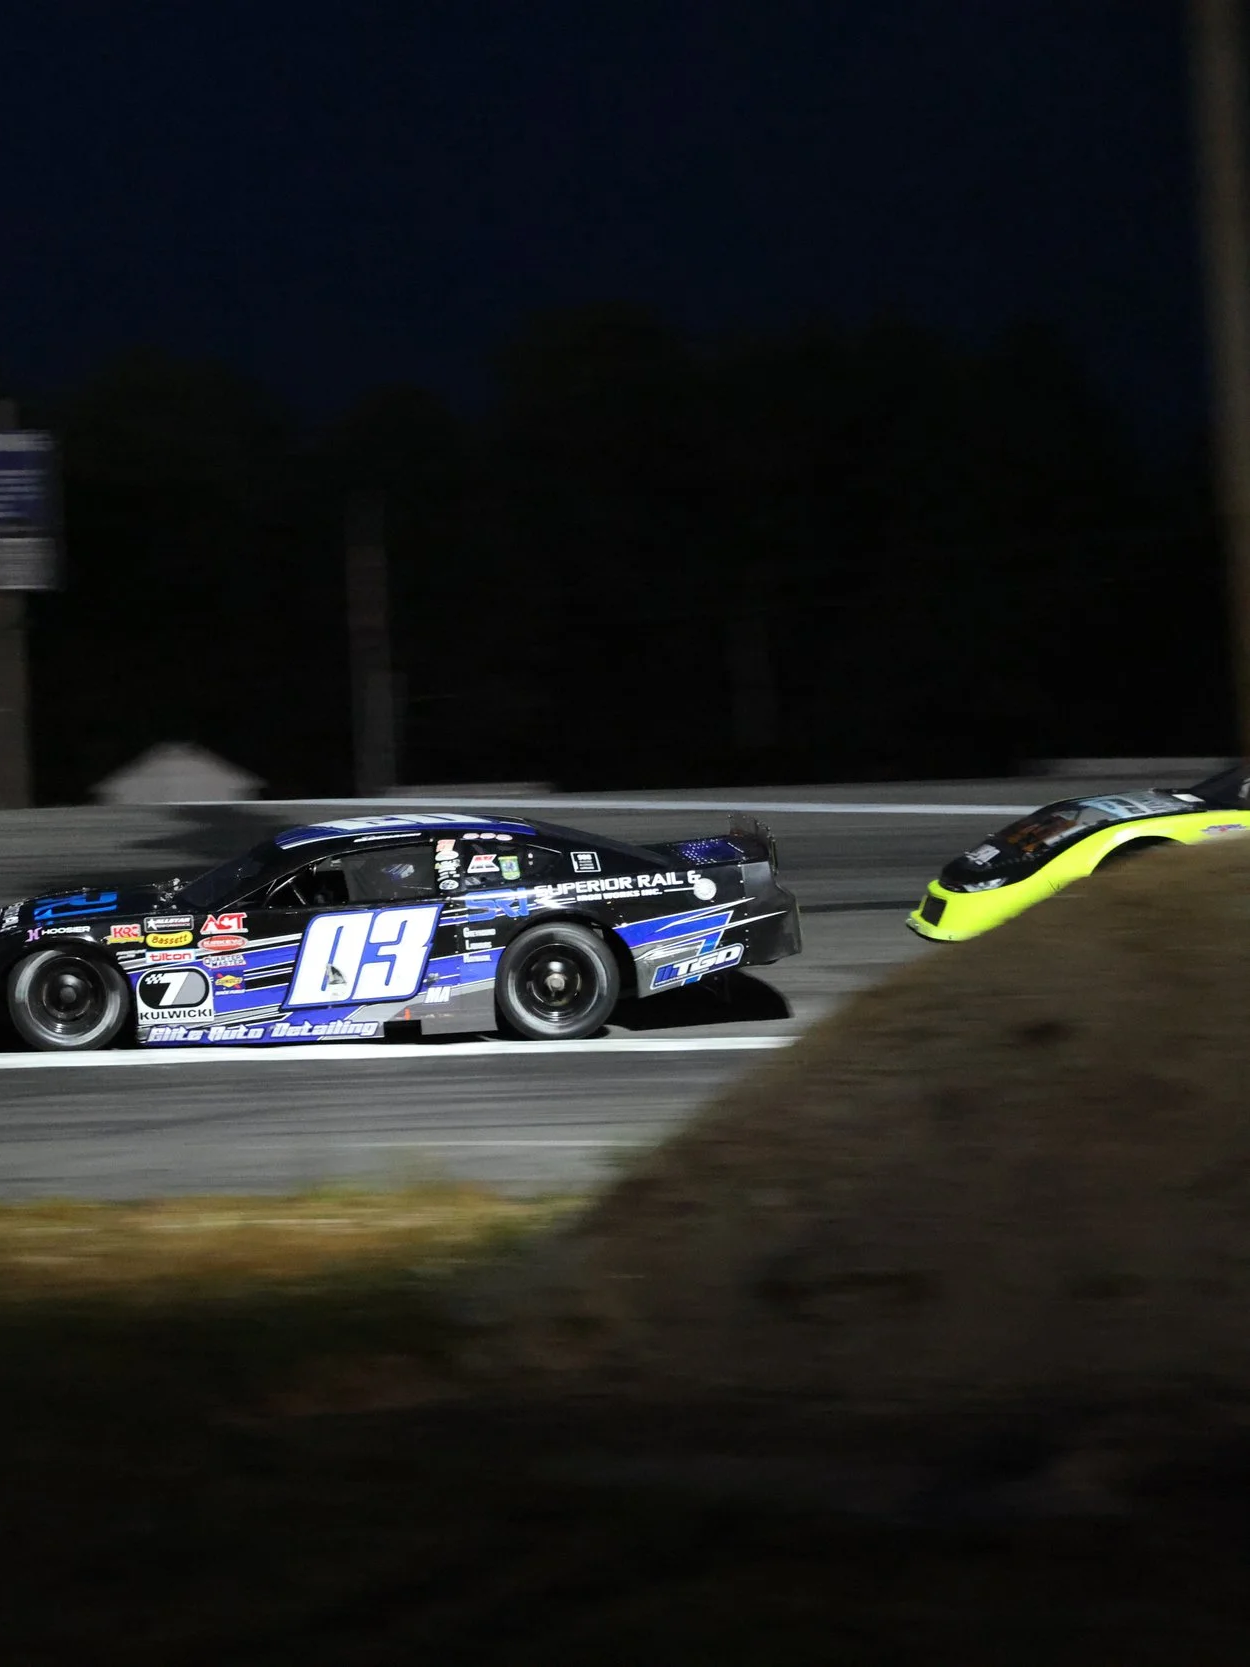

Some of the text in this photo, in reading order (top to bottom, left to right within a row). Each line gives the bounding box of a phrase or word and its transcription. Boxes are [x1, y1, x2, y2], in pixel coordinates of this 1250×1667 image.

[534, 870, 702, 899] SUPERIOR RAIL &
[41, 926, 91, 935] HOOSIER
[201, 913, 247, 933] ACT
[152, 934, 188, 944] Bassett
[150, 952, 192, 962] tilton
[287, 906, 442, 1006] 03
[145, 973, 189, 1006] 7
[140, 1009, 212, 1020] KULWICKI
[148, 1019, 379, 1042] Elite Auto Detailing
